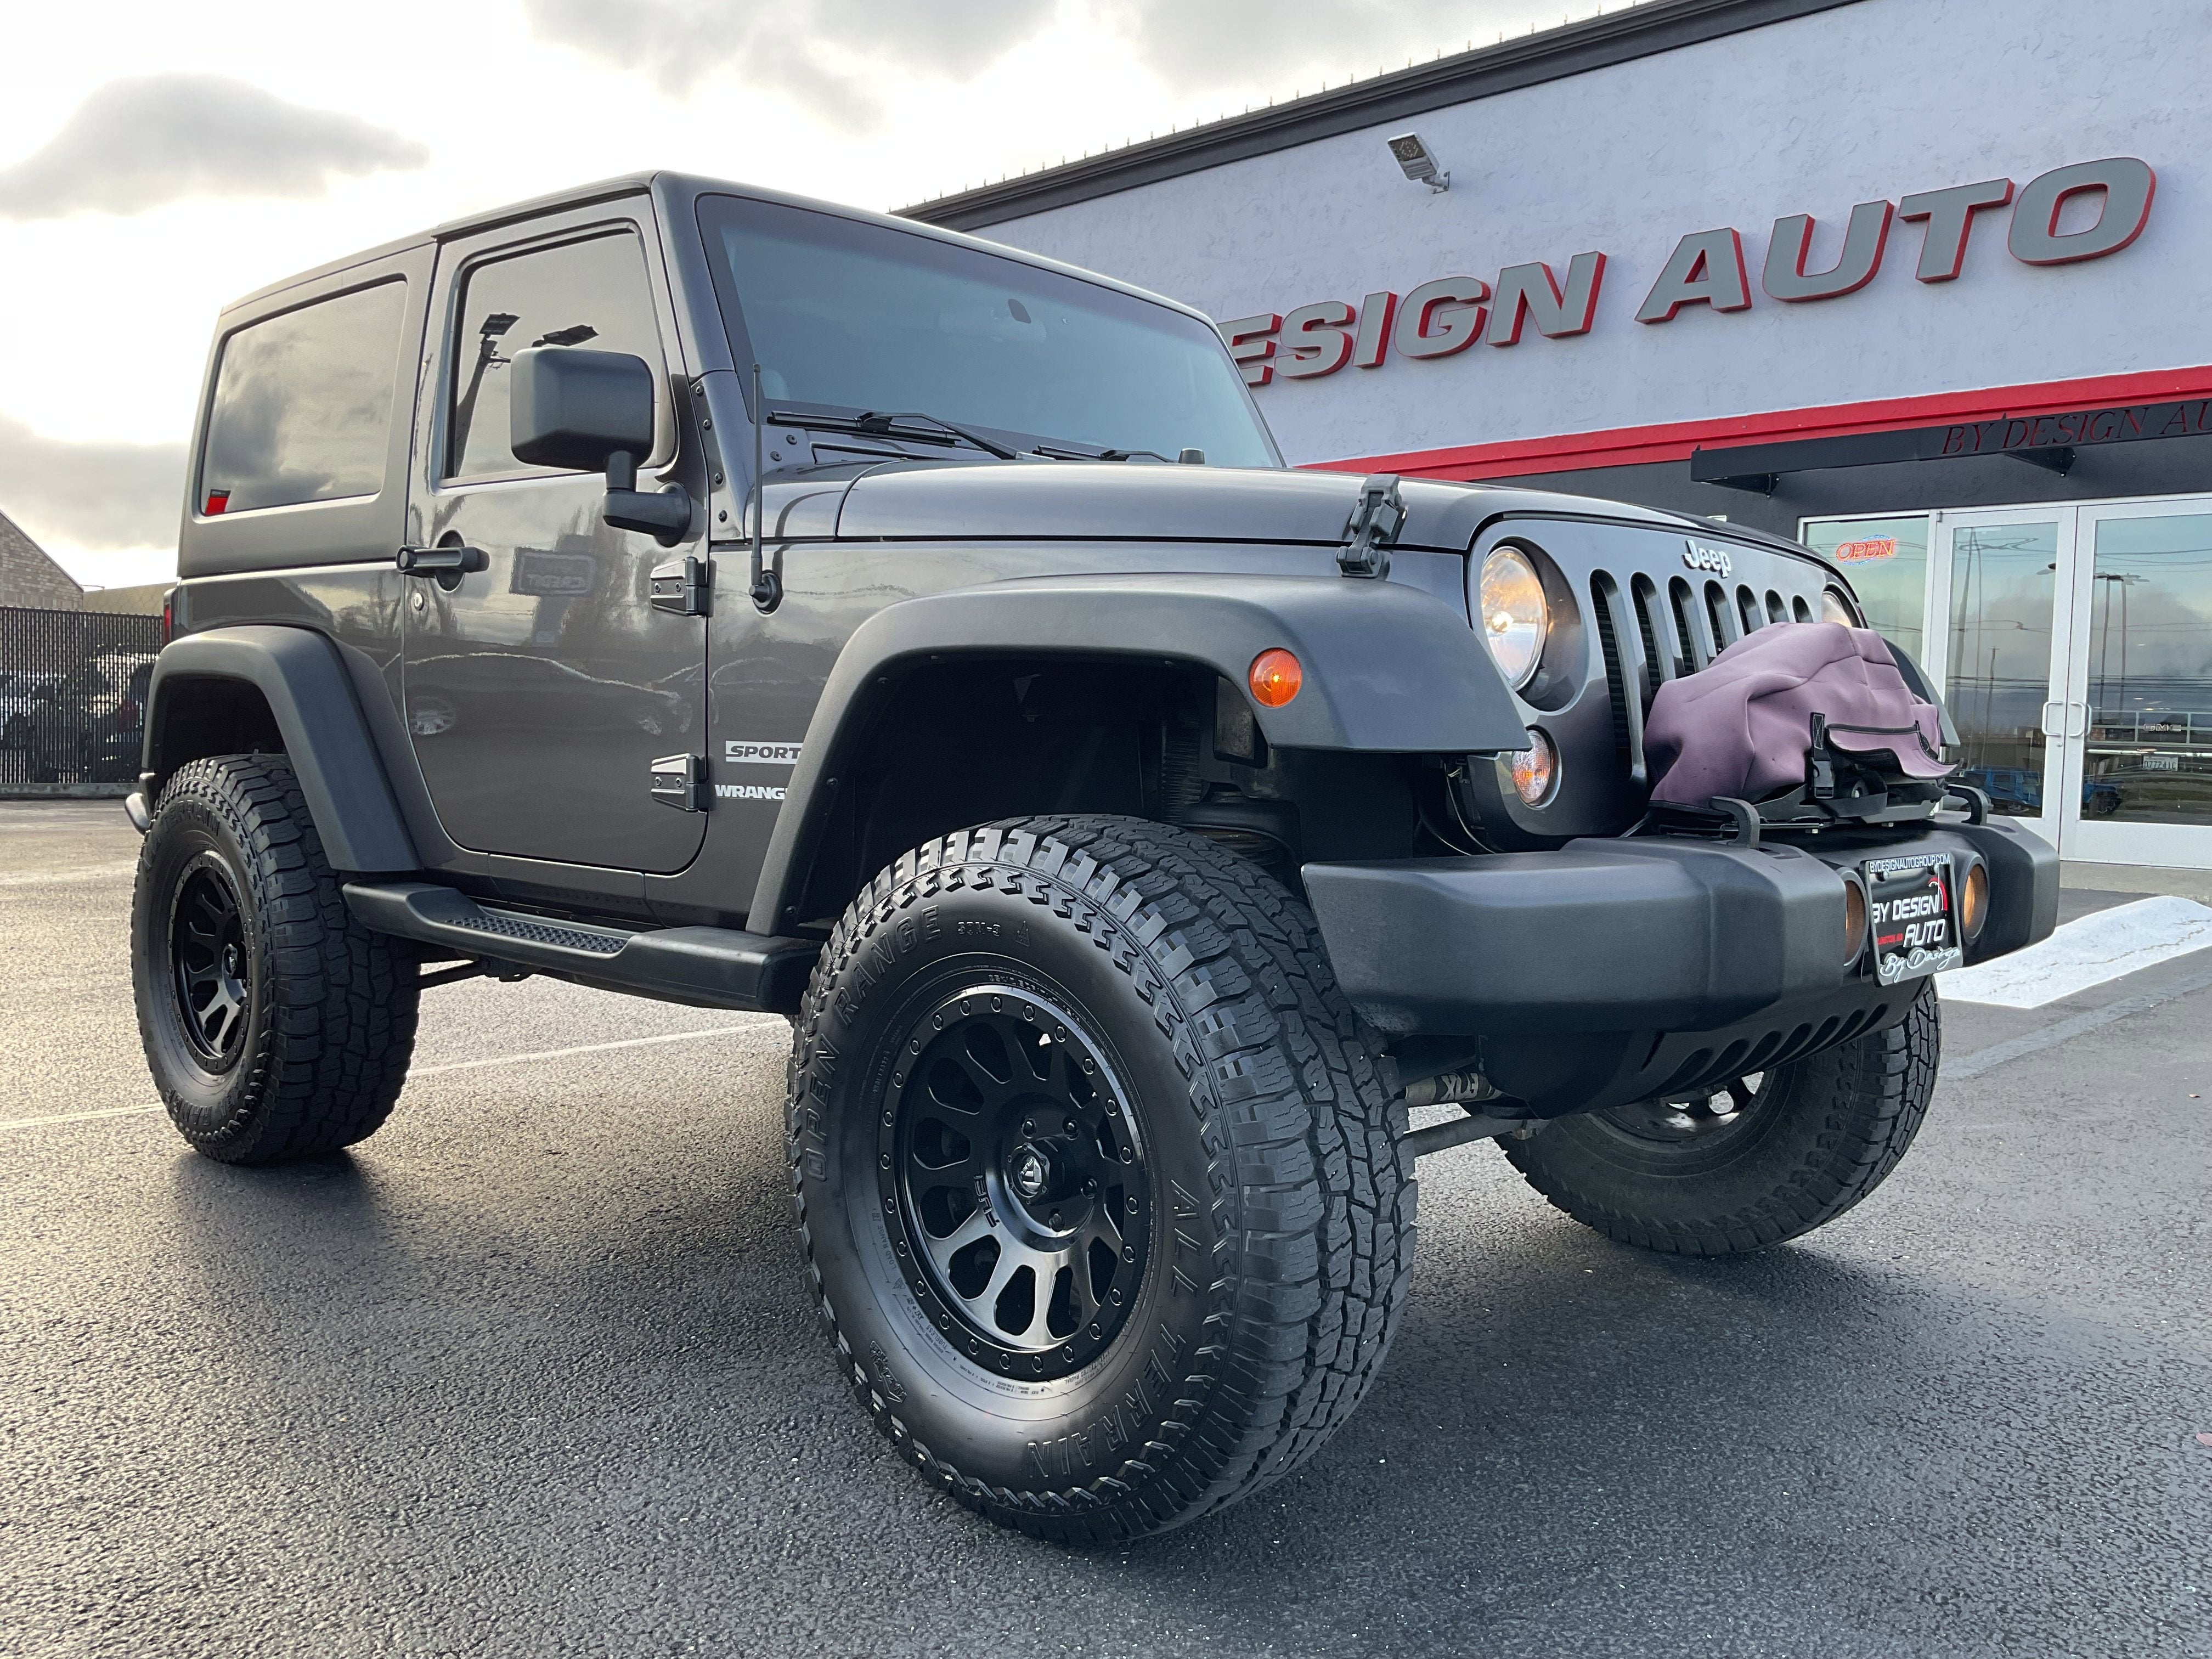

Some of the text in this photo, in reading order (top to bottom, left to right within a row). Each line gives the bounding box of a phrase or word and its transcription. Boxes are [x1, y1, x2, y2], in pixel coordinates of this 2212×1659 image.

[1215, 157, 2156, 386] ESIGN AUTO
[1942, 422, 1995, 454] BY
[2001, 407, 2150, 450] DESIGN
[1682, 540, 1731, 579] Jeep
[1836, 539, 1896, 561] OPEN
[2143, 723, 2181, 732] GMC
[727, 746, 802, 759] SPORT
[715, 785, 788, 800] WRANG
[1872, 895, 1939, 923] BY DESIGN
[1903, 918, 1945, 948] AUTO
[1880, 947, 1960, 983] By Design
[806, 1033, 839, 1181] OPEN
[833, 905, 943, 1026] RANGE
[973, 1162, 1000, 1228] FUEL
[877, 1224, 889, 1249] RANGE
[1171, 1179, 1202, 1299] ALL
[884, 1250, 896, 1269] LOAD
[1028, 1323, 1187, 1478] TERRAIN
